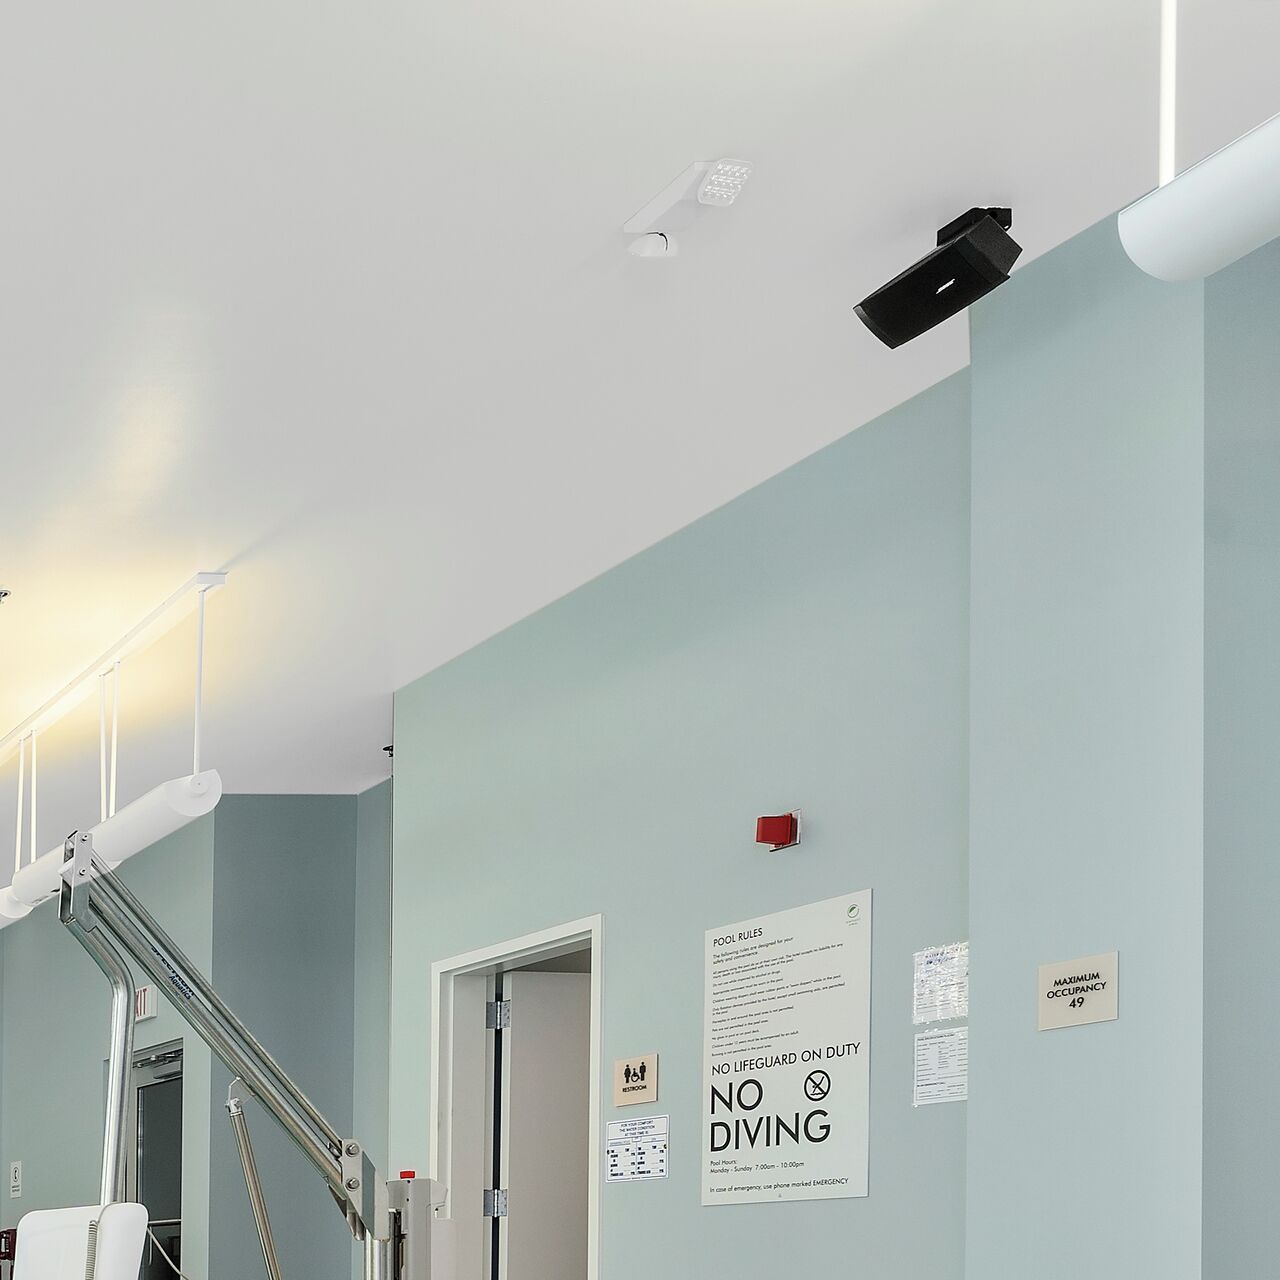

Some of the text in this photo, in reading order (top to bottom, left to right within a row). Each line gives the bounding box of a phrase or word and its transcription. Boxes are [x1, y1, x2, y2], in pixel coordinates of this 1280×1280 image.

[713, 927, 763, 947] POOL RULES
[1053, 971, 1100, 987] MAXIMUM
[1046, 981, 1107, 999] OCCUPANCY
[1068, 997, 1085, 1009] 49
[711, 1042, 861, 1076] NO LIFEGUARD ON DUTY
[622, 1084, 647, 1093] RESTROOM
[710, 1079, 763, 1115] NO
[710, 1109, 831, 1153] DIVING
[734, 1165, 752, 1173] Sunday
[773, 1182, 790, 1190] phone
[791, 1180, 812, 1188] marked
[813, 1177, 849, 1186] EMERGENCY
